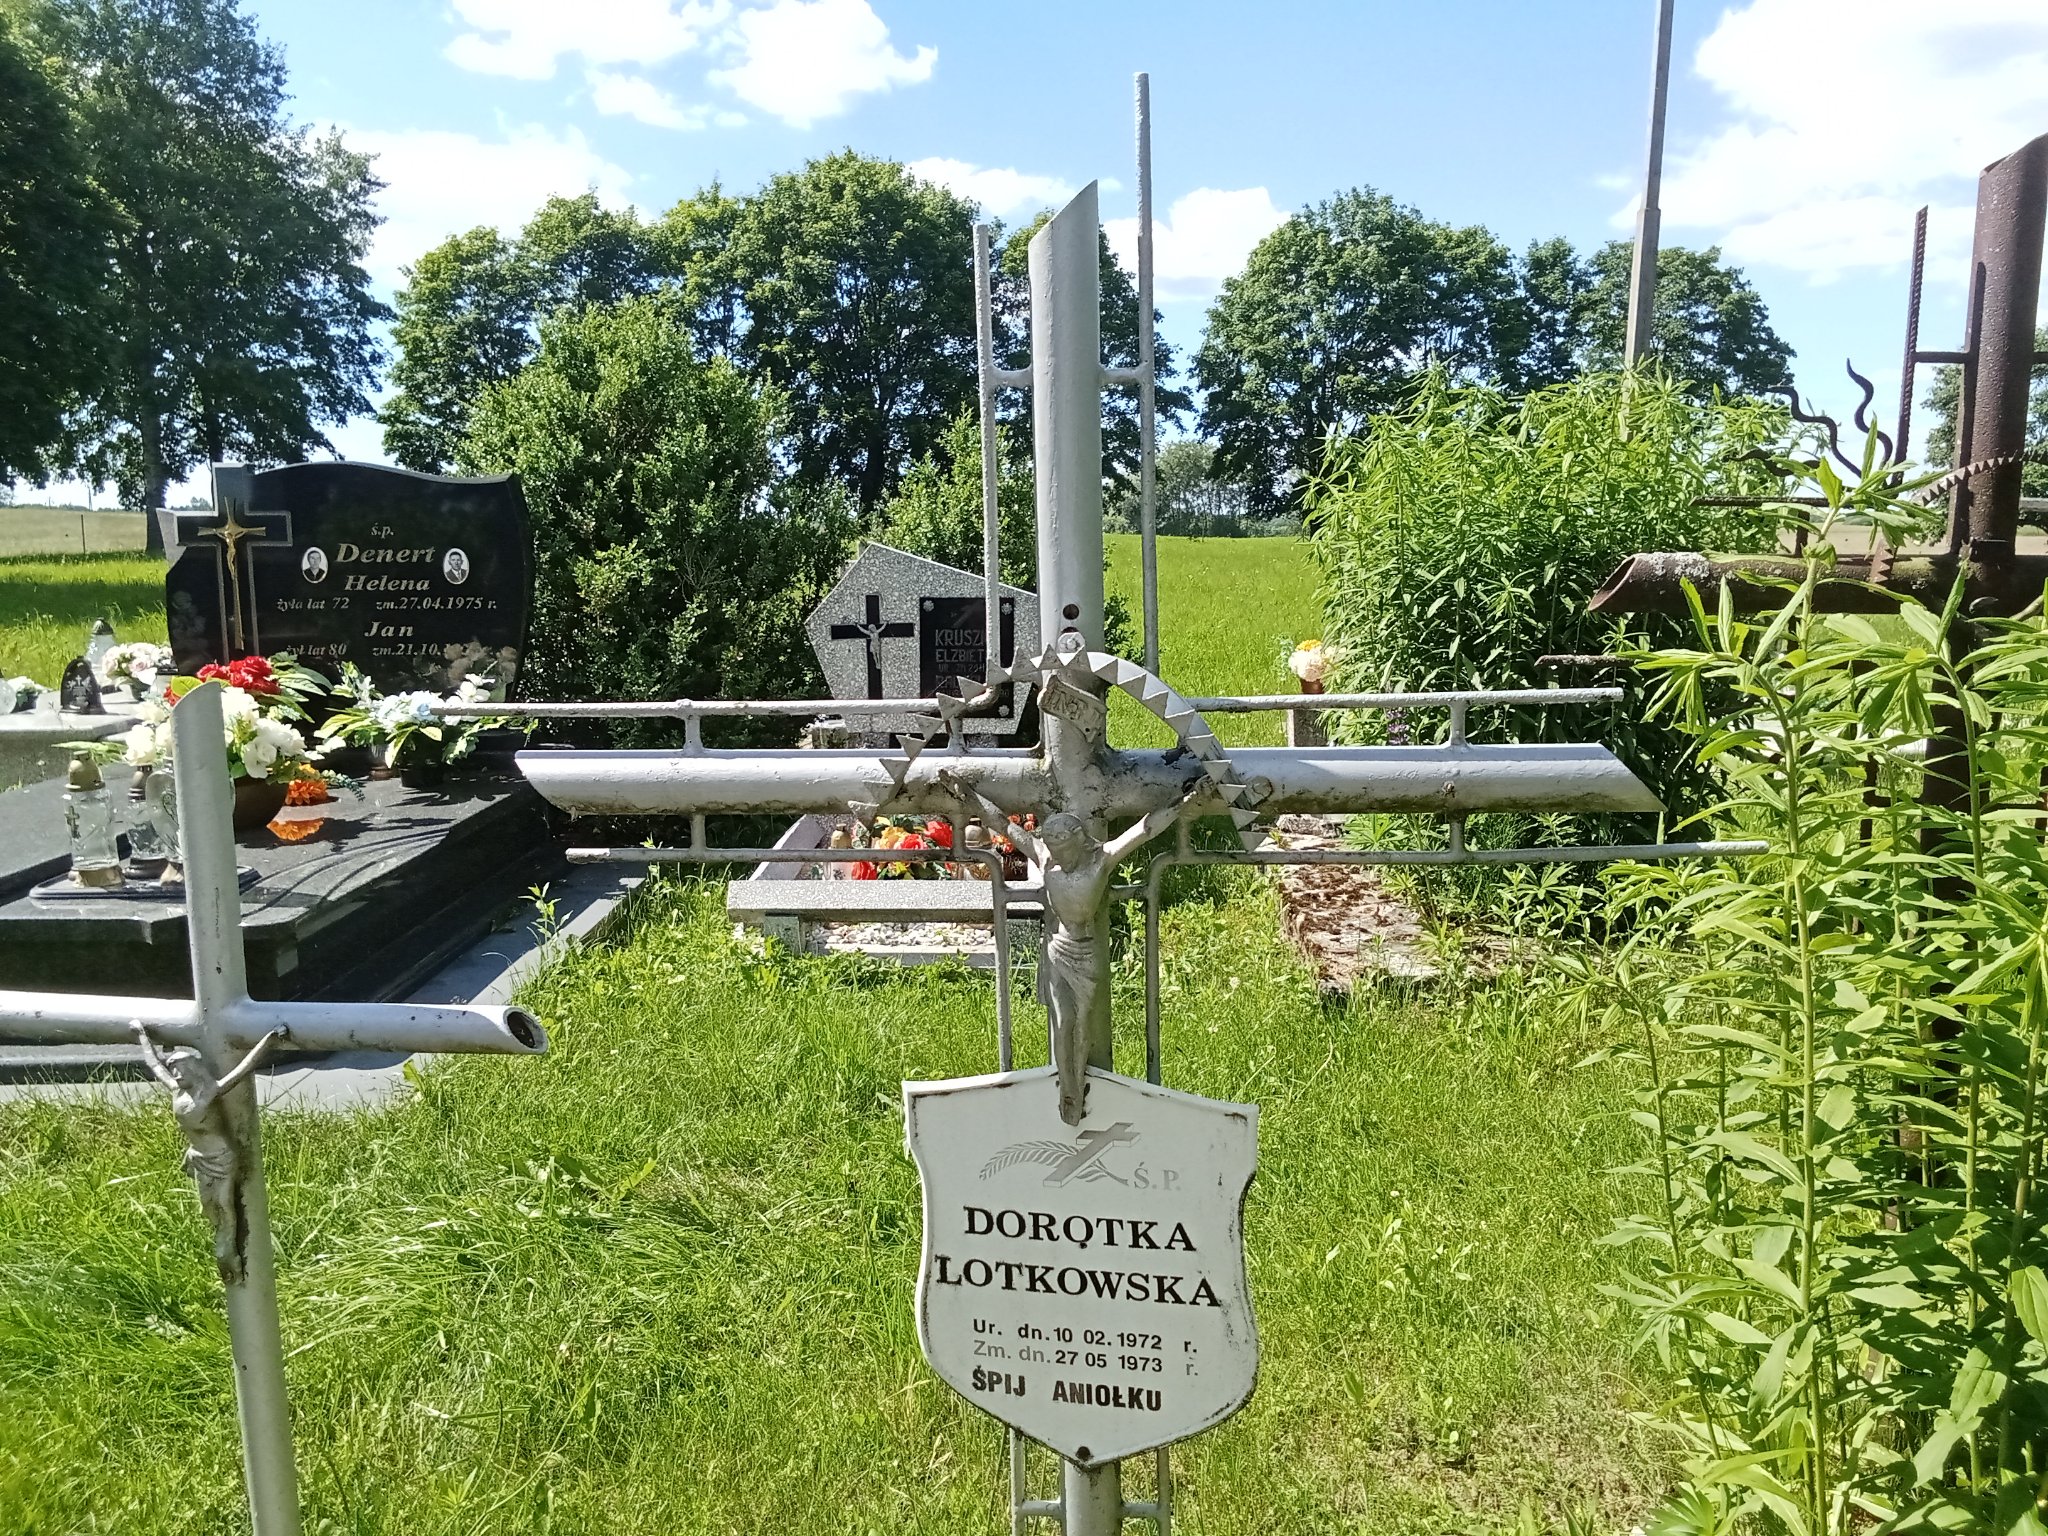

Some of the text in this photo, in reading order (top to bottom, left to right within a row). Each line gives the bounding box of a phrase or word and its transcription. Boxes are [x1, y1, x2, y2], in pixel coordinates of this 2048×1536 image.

[334, 543, 436, 563] Denert
[344, 575, 430, 591] Helena
[277, 598, 303, 611] żyła
[307, 598, 325, 610] lat
[332, 597, 350, 609] 72
[364, 621, 414, 637] Jan
[935, 629, 986, 647] KRUSZ
[307, 645, 326, 656] lat
[329, 643, 348, 656] 80
[963, 1206, 1197, 1251] DOROTKA
[934, 1254, 1221, 1307] LOTKOWSKA
[973, 1318, 1002, 1335] Ur.
[1184, 1339, 1197, 1352] r.
[973, 1340, 1011, 1359] Zm.
[1085, 1352, 1107, 1368] 05
[1118, 1355, 1162, 1372] 1973
[1186, 1363, 1198, 1376] r.
[972, 1365, 1162, 1411] ŚPIJ ANIOŁKU
